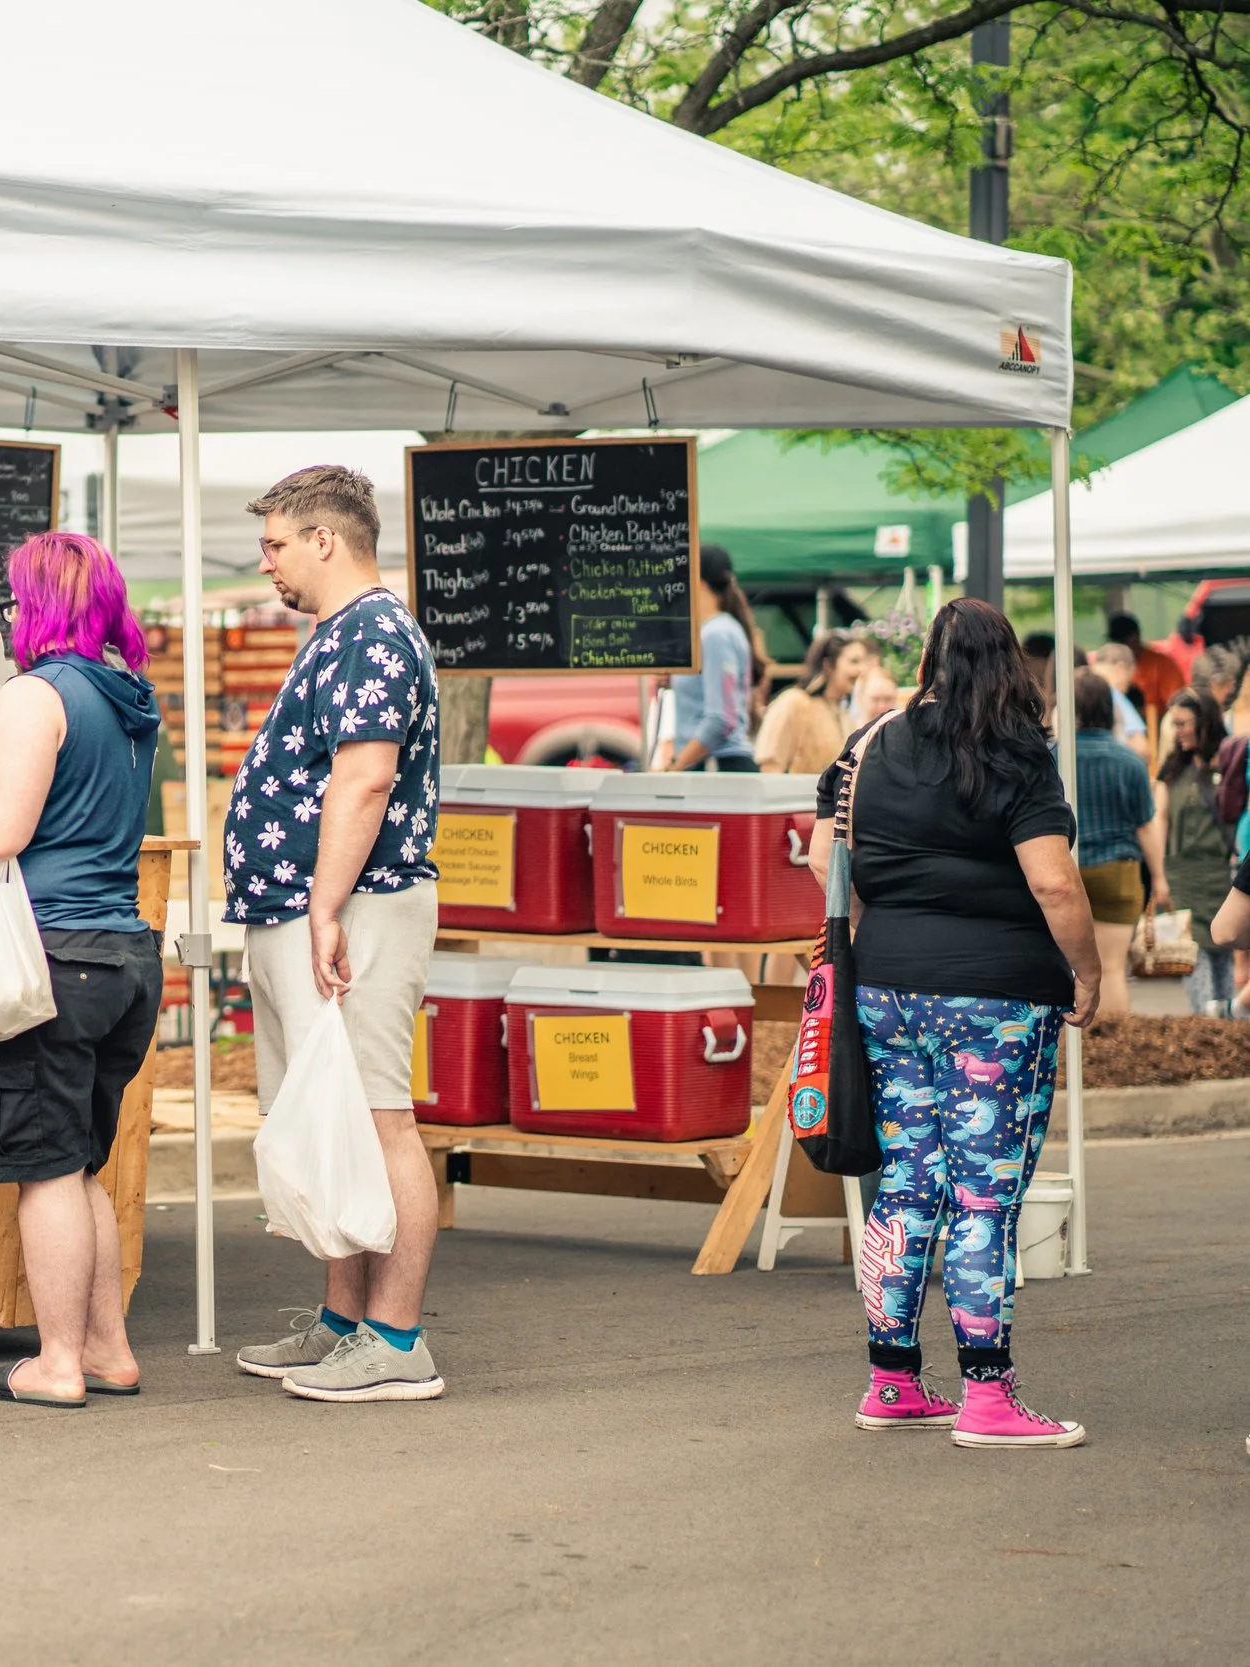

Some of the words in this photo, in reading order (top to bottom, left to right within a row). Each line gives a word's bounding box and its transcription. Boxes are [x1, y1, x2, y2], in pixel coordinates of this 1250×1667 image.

[475, 452, 596, 487] CHICKEN
[420, 495, 456, 521] Whole
[458, 499, 501, 518] Chicken
[571, 494, 617, 516] Ground
[617, 494, 661, 515] Chicken
[568, 522, 625, 543] Chicken
[626, 520, 664, 542] Brats
[424, 533, 468, 556] Breast
[569, 557, 624, 579] Chicken
[422, 567, 476, 598] Thighs
[568, 581, 616, 601] Chicken
[425, 606, 473, 625] Drums
[442, 827, 494, 842] CHICKEN
[641, 841, 699, 857] CHICKEN
[642, 874, 672, 886] Whole
[674, 874, 698, 887] Birds
[554, 1031, 610, 1045] CHICKEN
[568, 1052, 599, 1064] Breast
[570, 1068, 599, 1082] Wings
